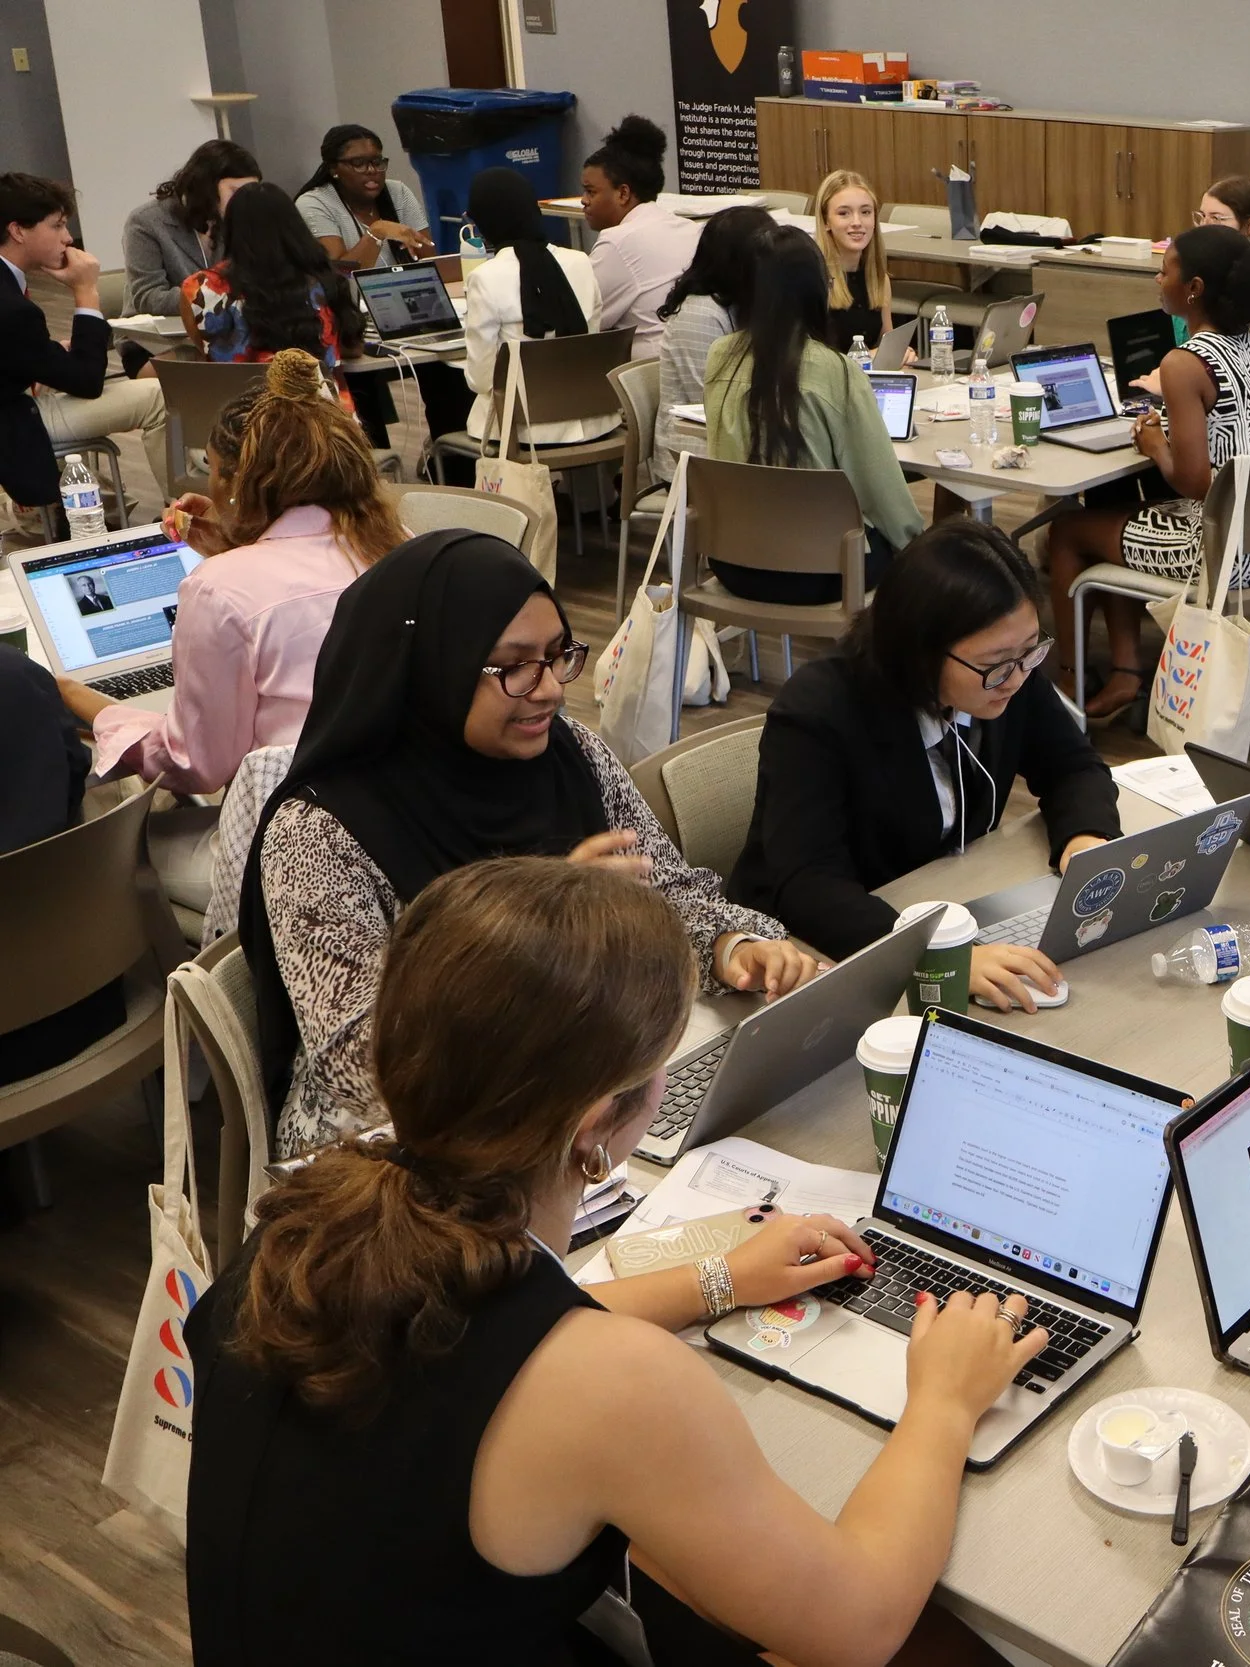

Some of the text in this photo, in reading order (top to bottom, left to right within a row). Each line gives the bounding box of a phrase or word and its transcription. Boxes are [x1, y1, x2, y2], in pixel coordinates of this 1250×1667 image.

[678, 101, 690, 110] The
[692, 102, 713, 113] Judge
[714, 103, 733, 113] Frank
[734, 105, 741, 113] M.
[680, 114, 707, 123] Institute
[708, 115, 714, 123] is
[684, 126, 756, 138] that shares the stories
[682, 137, 723, 148] Constitution
[723, 141, 737, 149] and
[680, 148, 706, 159] through
[706, 151, 738, 161] programs
[738, 153, 752, 161] that
[683, 160, 760, 174] issues and perspectives
[680, 171, 714, 181] thoughtful
[714, 174, 728, 182] and
[728, 175, 742, 183] civil
[681, 182, 702, 192] inspire
[870, 1090, 891, 1103] GET
[720, 1159, 731, 1168] U.S.
[731, 1164, 750, 1175] Courts
[756, 1174, 779, 1185] Appeals
[616, 1223, 741, 1268] Sully
[154, 1414, 187, 1439] Supreme
[1230, 1586, 1245, 1603] OF
[1229, 1607, 1247, 1638] SEAL
